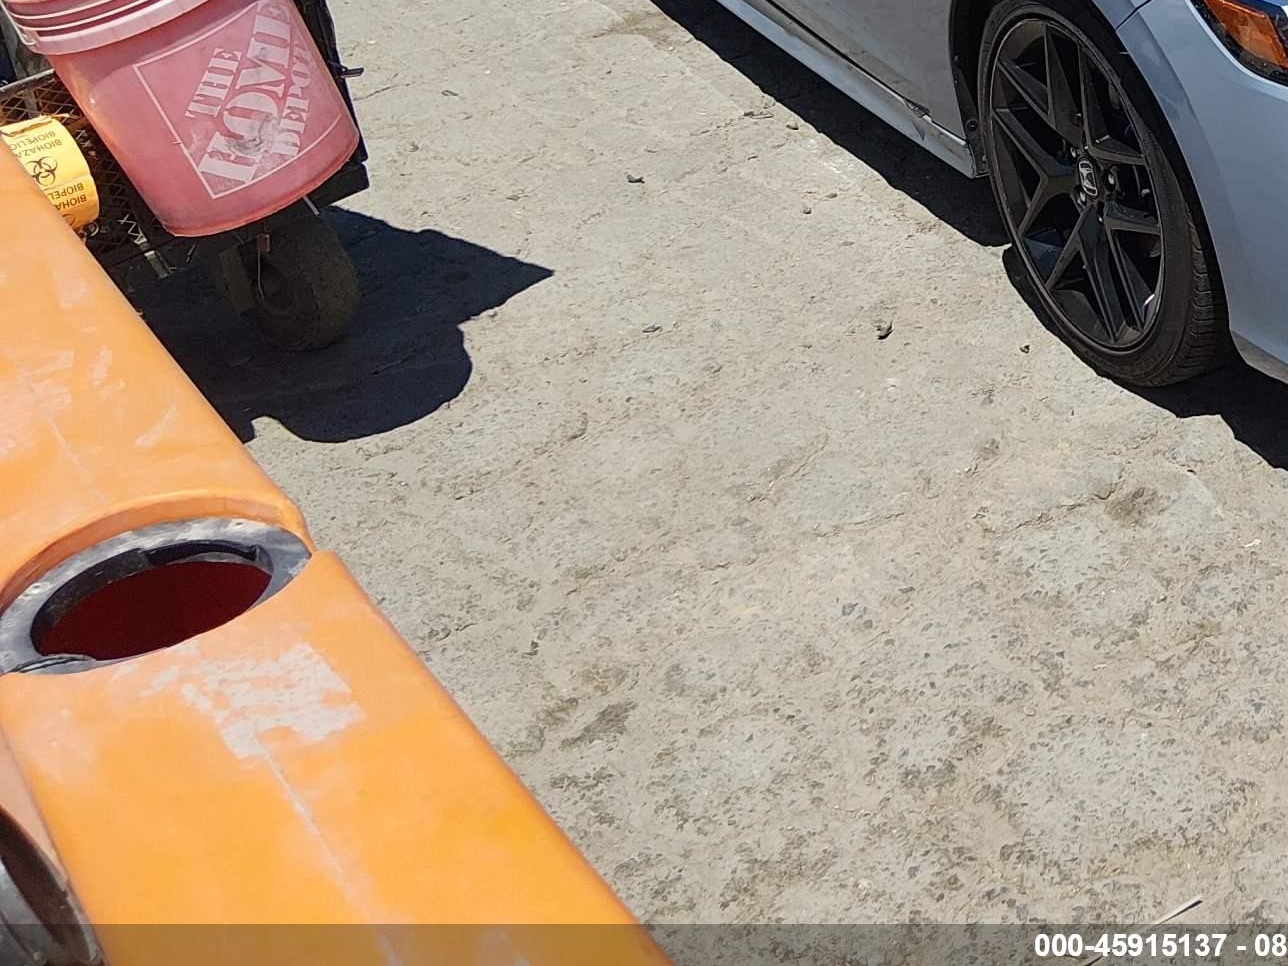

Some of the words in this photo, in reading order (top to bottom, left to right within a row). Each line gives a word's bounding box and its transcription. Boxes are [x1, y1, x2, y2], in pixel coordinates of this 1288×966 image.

[184, 47, 242, 118] THE
[199, 0, 291, 183] HOME
[48, 182, 84, 201] BIOPEL
[55, 194, 87, 211] BIOHA
